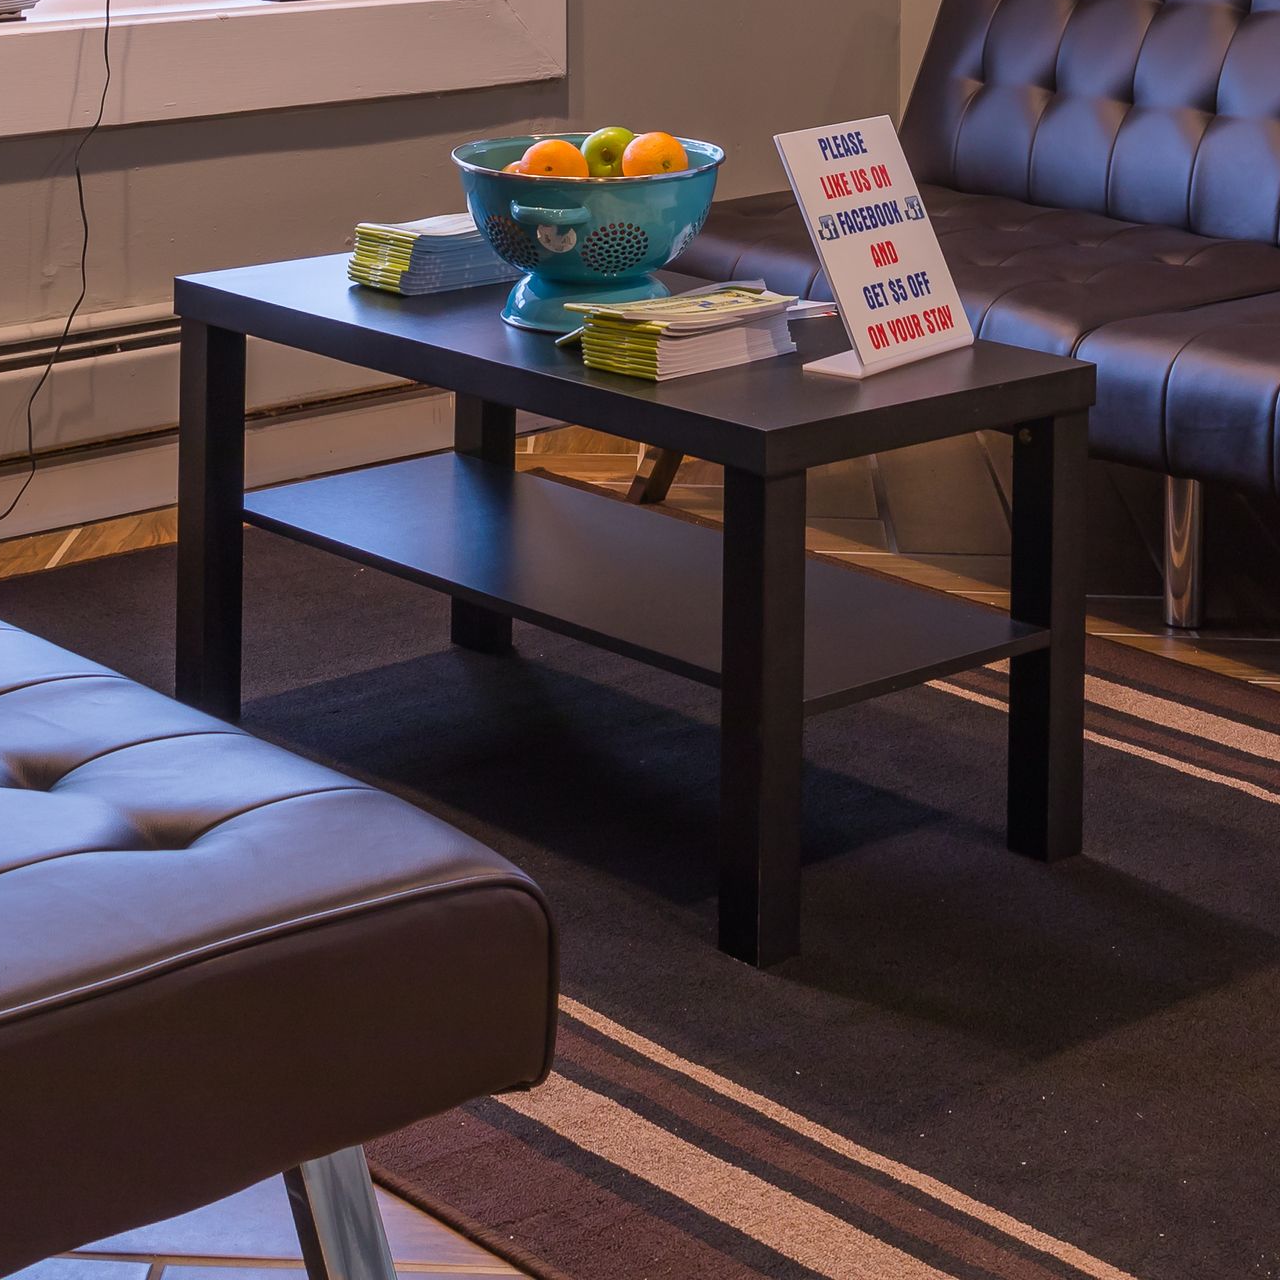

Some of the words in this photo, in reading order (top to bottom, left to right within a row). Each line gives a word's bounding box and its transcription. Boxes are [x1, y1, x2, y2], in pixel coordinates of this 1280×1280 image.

[817, 131, 868, 161] PLEASE
[819, 172, 852, 200] LIKE
[850, 168, 872, 194] US
[870, 164, 892, 189] ON
[836, 200, 904, 236] FACEBOOK
[870, 240, 899, 268] AND
[862, 282, 889, 310] GET
[888, 278, 908, 305] $5
[906, 271, 931, 298] OFF
[867, 323, 890, 350] ON
[887, 314, 925, 344] YOUR
[923, 304, 955, 334] STAY
